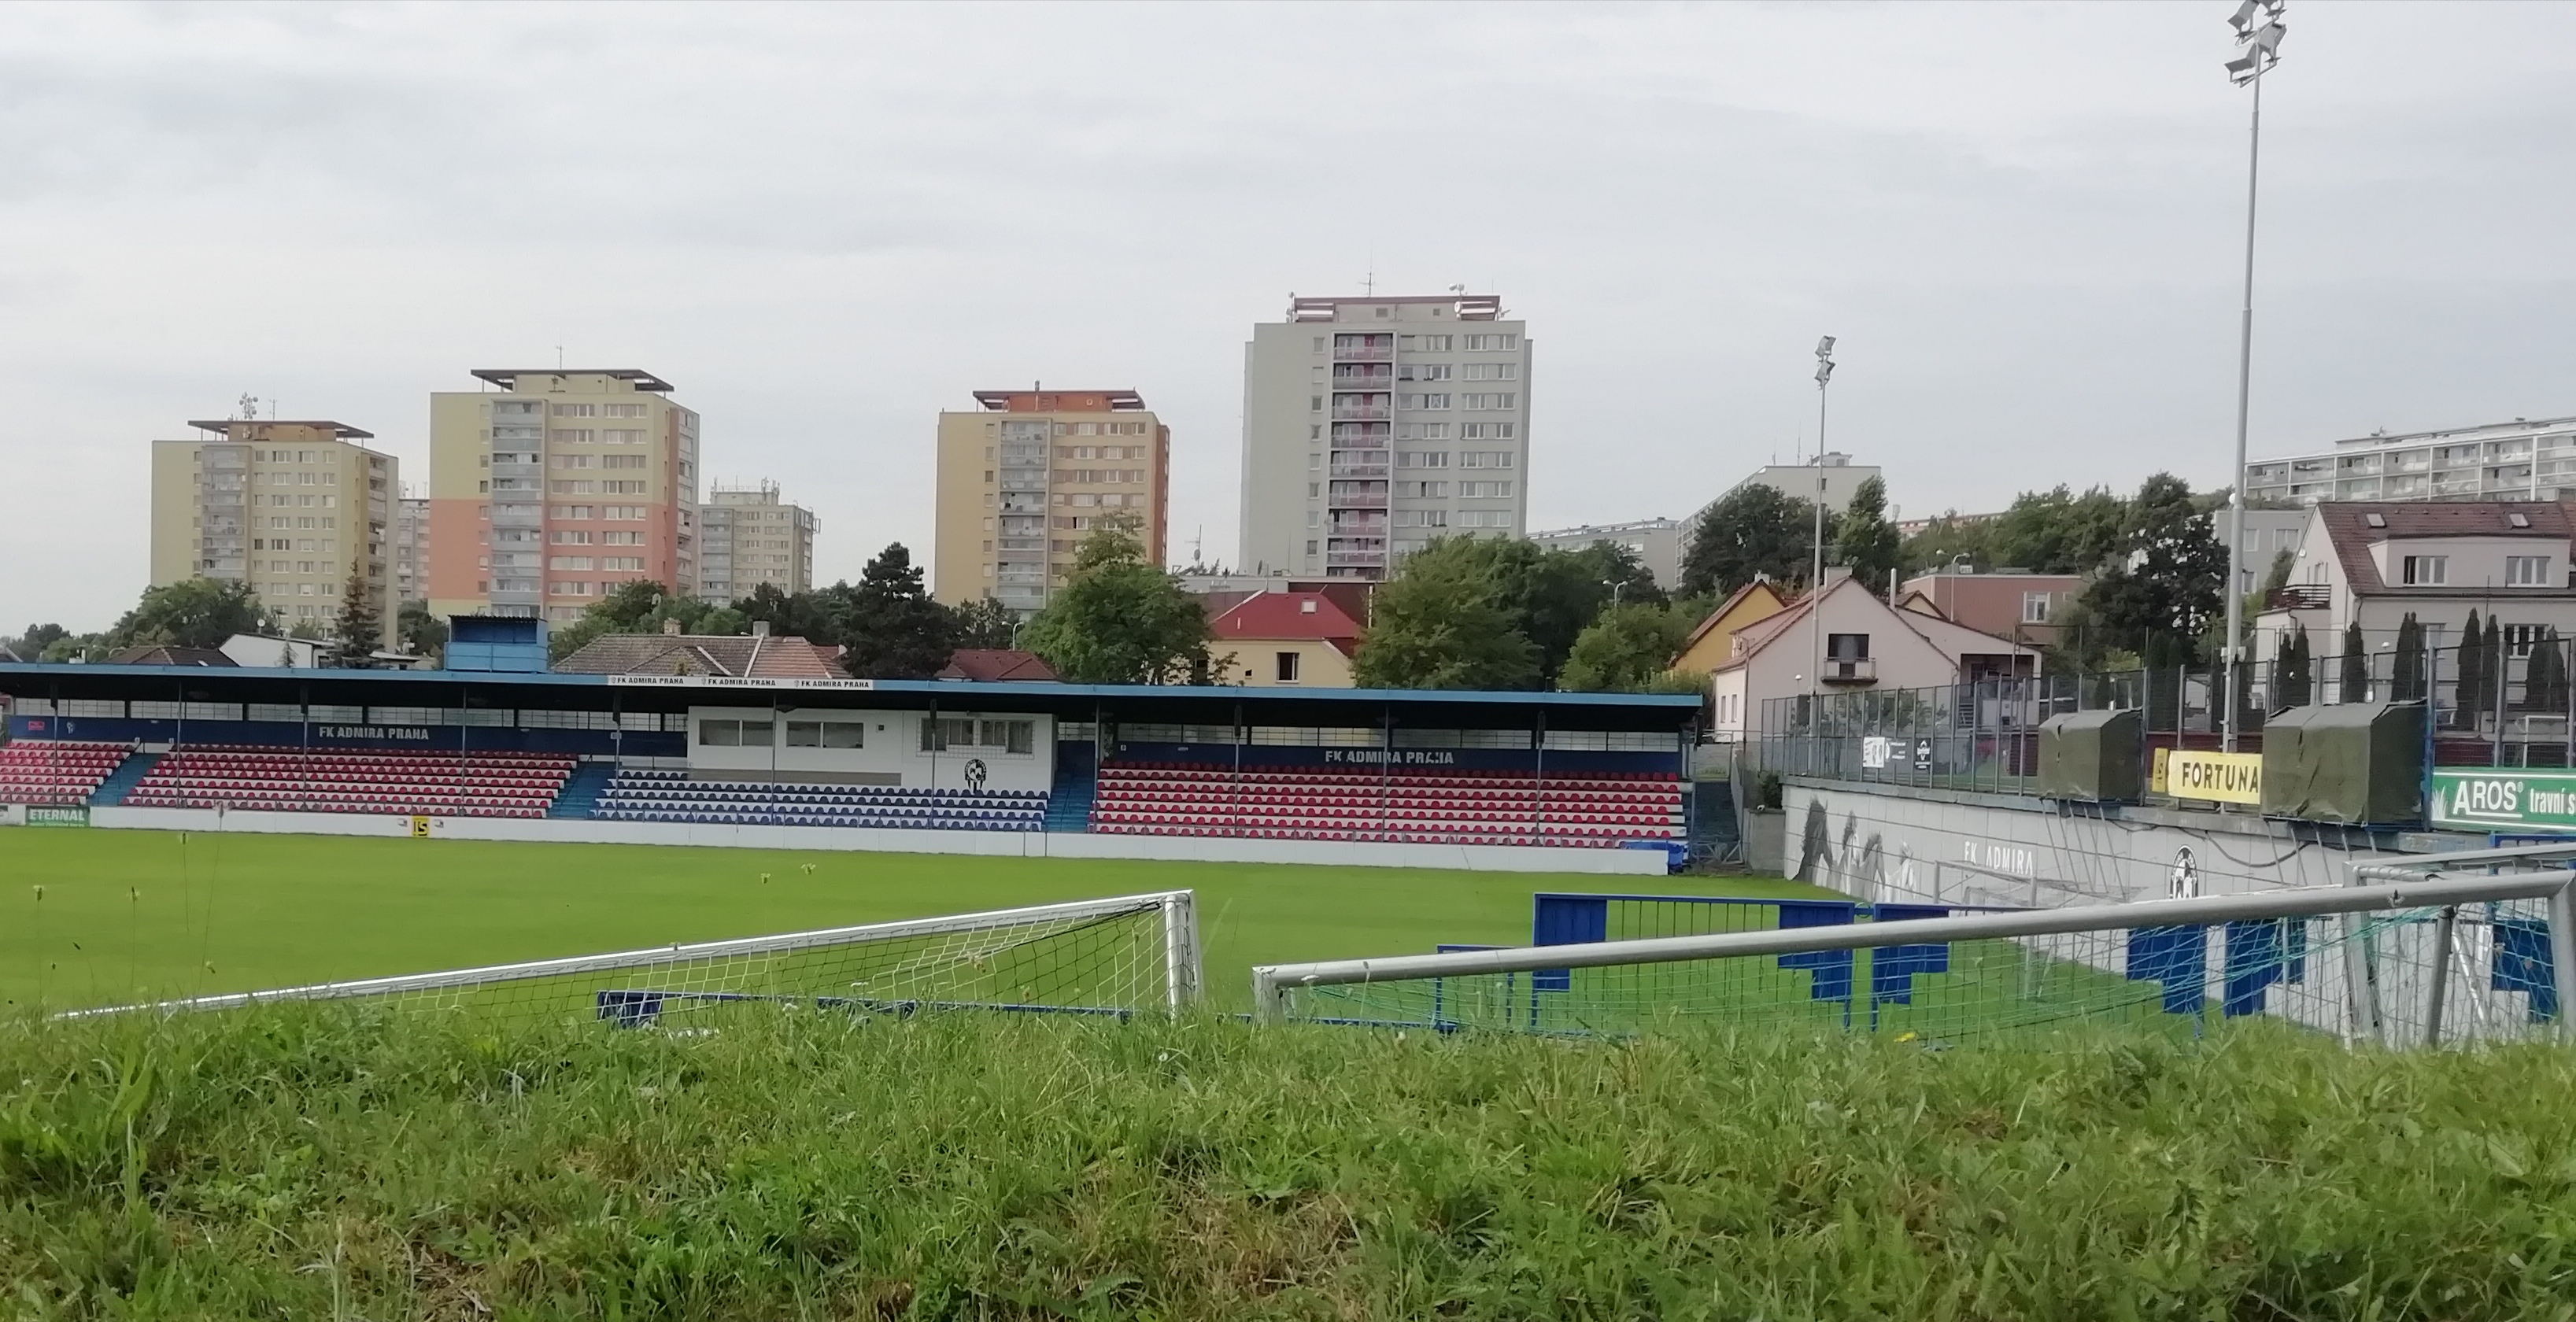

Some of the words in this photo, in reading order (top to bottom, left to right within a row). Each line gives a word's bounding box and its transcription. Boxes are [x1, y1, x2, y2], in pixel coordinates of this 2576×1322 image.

[319, 726, 334, 738] FK
[337, 726, 385, 739] ADMIRA
[388, 728, 429, 740] PRAHA
[1325, 750, 1342, 763] FK
[1346, 751, 1402, 763] ADMIRA
[2182, 762, 2259, 793] FORTUNA
[2530, 787, 2566, 814] travní
[29, 808, 85, 821] ETERNAL
[1964, 840, 1977, 865] FK
[1986, 845, 2033, 876] ADMIRA
